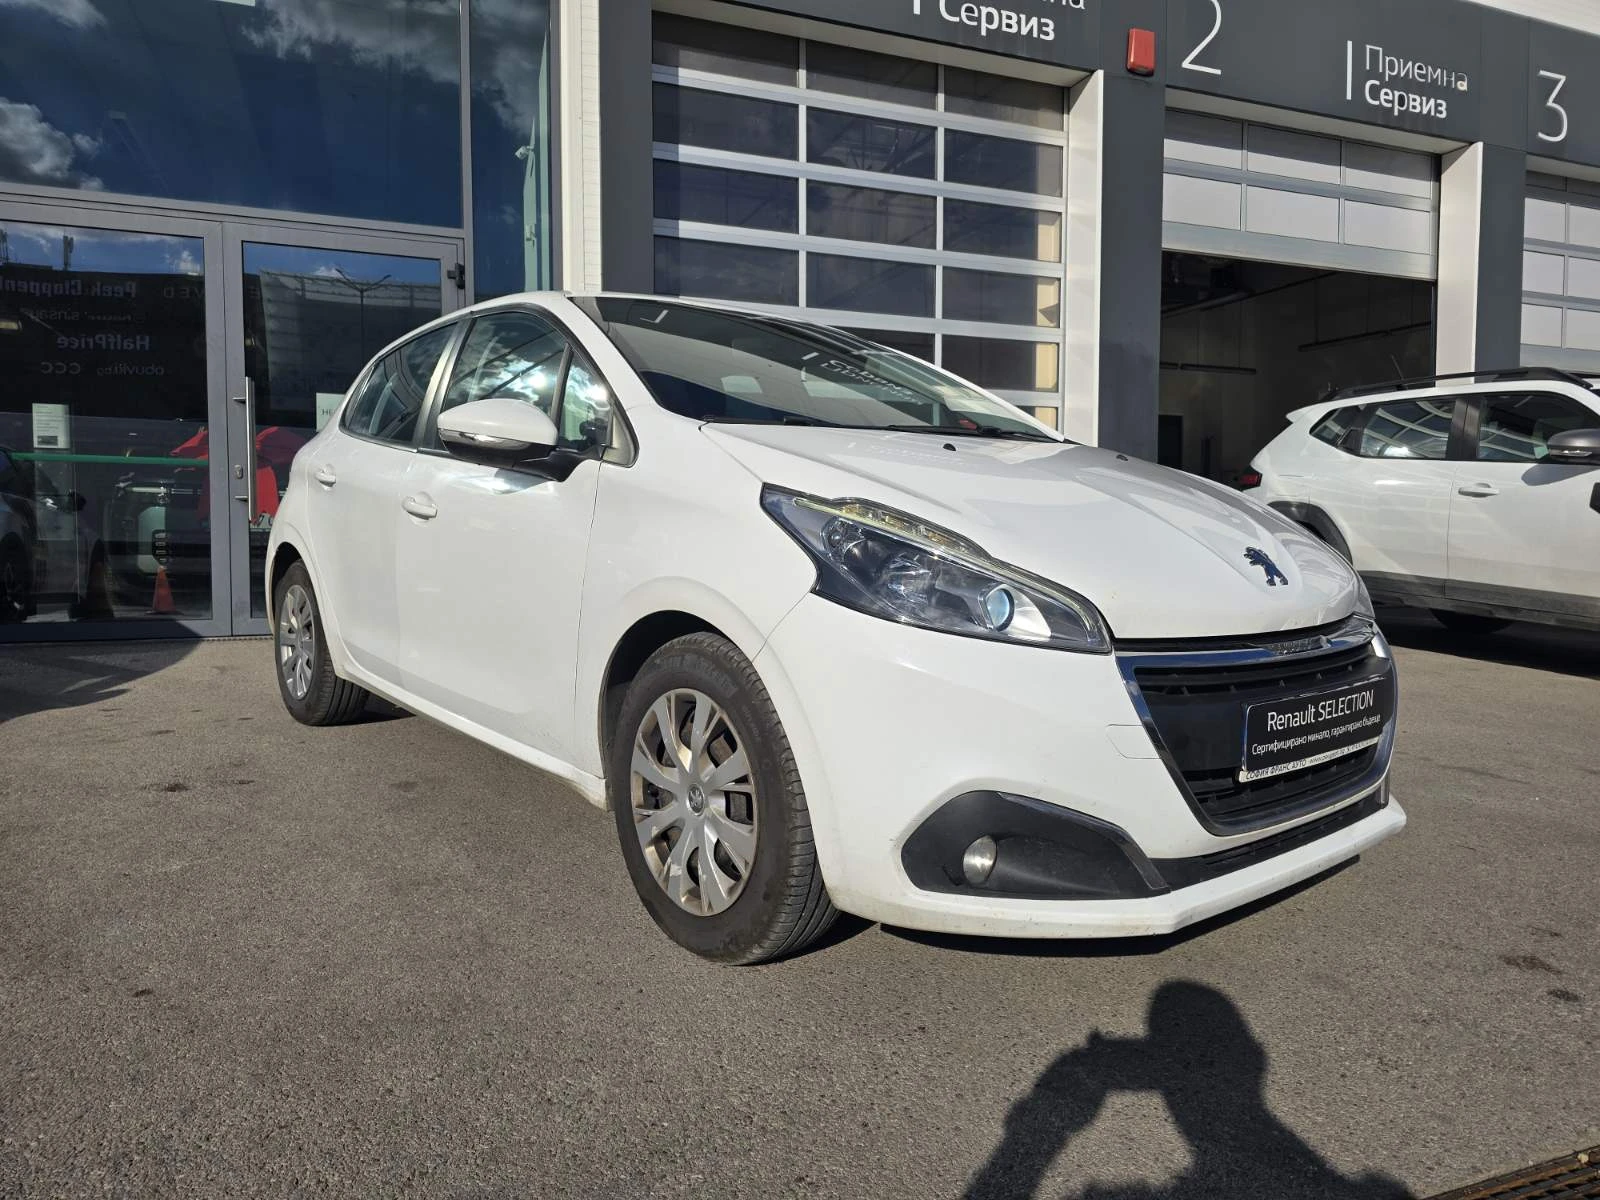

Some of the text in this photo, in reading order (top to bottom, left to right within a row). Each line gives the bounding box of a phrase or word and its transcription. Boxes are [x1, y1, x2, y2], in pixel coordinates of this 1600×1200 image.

[939, 0, 1055, 41] Сервиз
[1181, 0, 1222, 76] 2
[1365, 44, 1469, 92] Приемна
[1364, 79, 1448, 119] Сервиз
[1537, 69, 1568, 143] 3
[1267, 690, 1374, 732] Renault SELECTION
